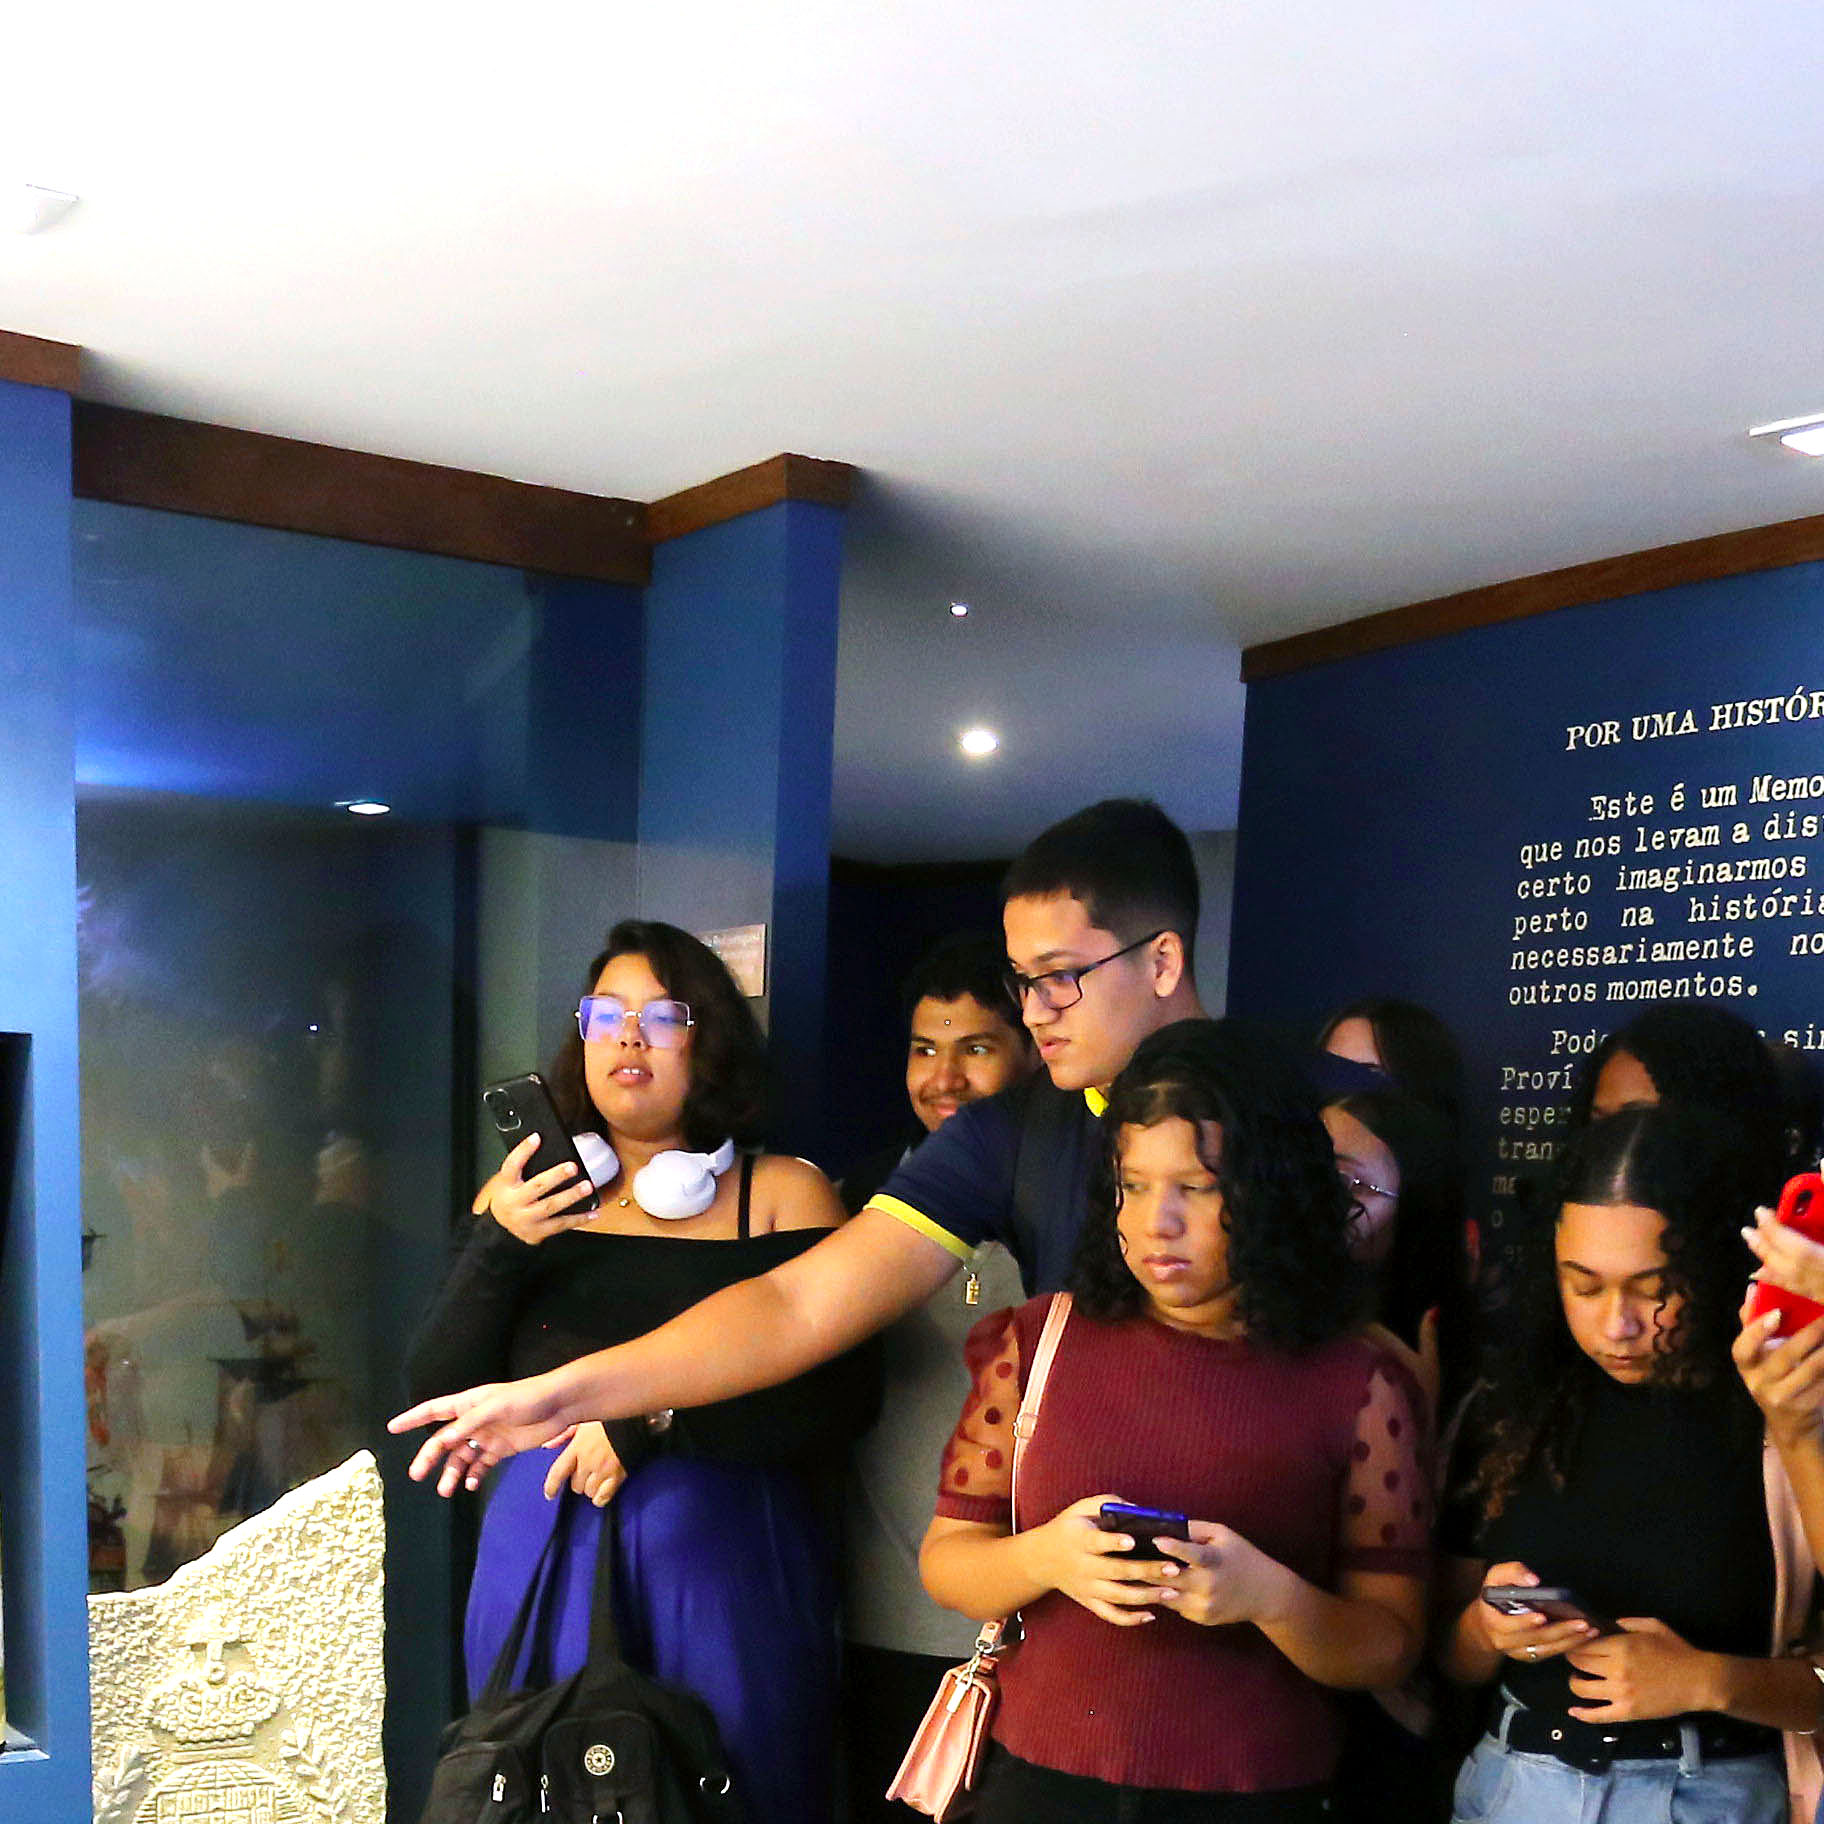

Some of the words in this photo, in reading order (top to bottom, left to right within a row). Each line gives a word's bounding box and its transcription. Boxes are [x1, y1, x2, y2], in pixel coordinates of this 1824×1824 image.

[1566, 725, 1621, 752] POR
[1631, 711, 1699, 744] UMA
[1589, 793, 1654, 823] Este
[1669, 782, 1686, 811] é
[1700, 783, 1738, 809] um
[1520, 838, 1563, 870] que
[1574, 831, 1621, 860] nos
[1635, 825, 1720, 853] levam
[1731, 821, 1751, 845] a
[1517, 873, 1591, 900] certo
[1616, 853, 1808, 894] imaginarmos
[1513, 907, 1588, 941] perto
[1620, 904, 1655, 928] na
[1510, 932, 1755, 971] necessariamente
[1509, 976, 1597, 1006] outros
[1605, 970, 1759, 1002] momentos.
